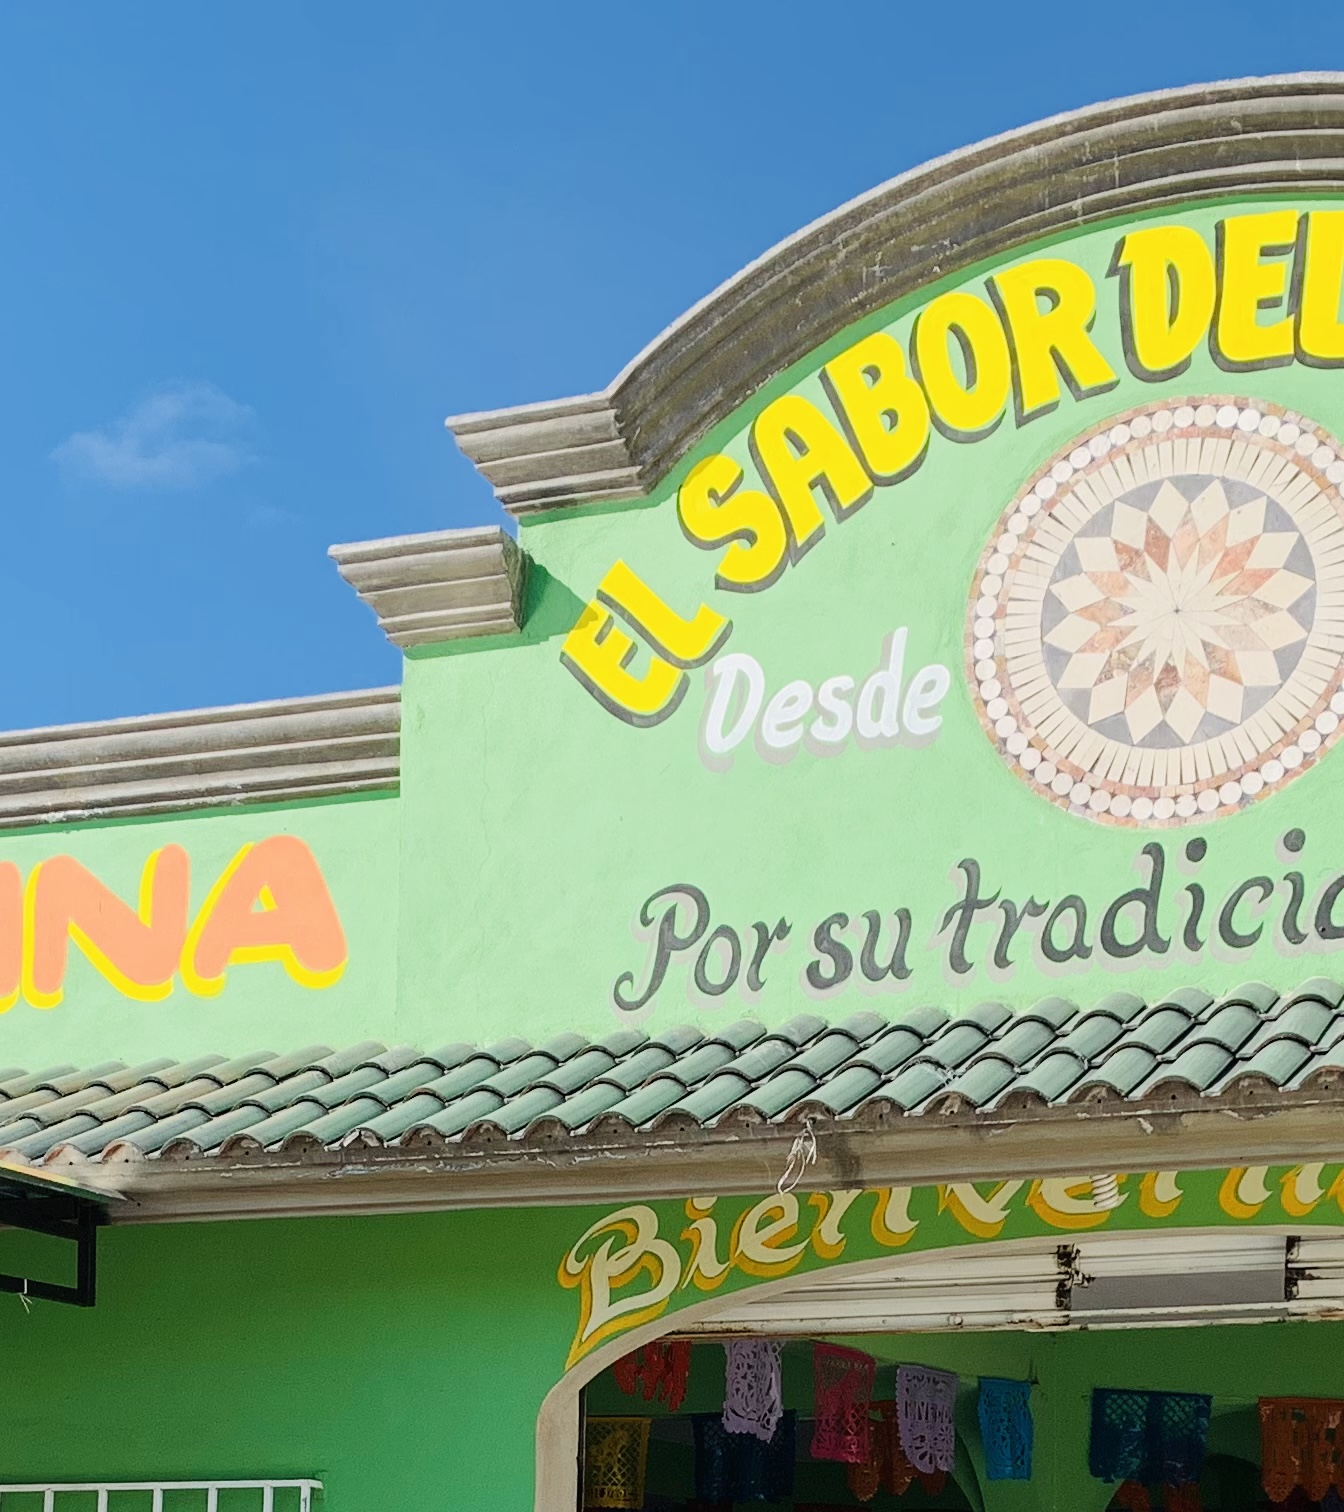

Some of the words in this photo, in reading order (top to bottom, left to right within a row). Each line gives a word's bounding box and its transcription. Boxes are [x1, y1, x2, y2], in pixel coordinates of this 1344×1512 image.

[561, 559, 733, 727] EL
[678, 258, 1119, 591] SABOR
[699, 627, 950, 766] Desde
[613, 883, 792, 1012] Por
[805, 906, 913, 990] su
